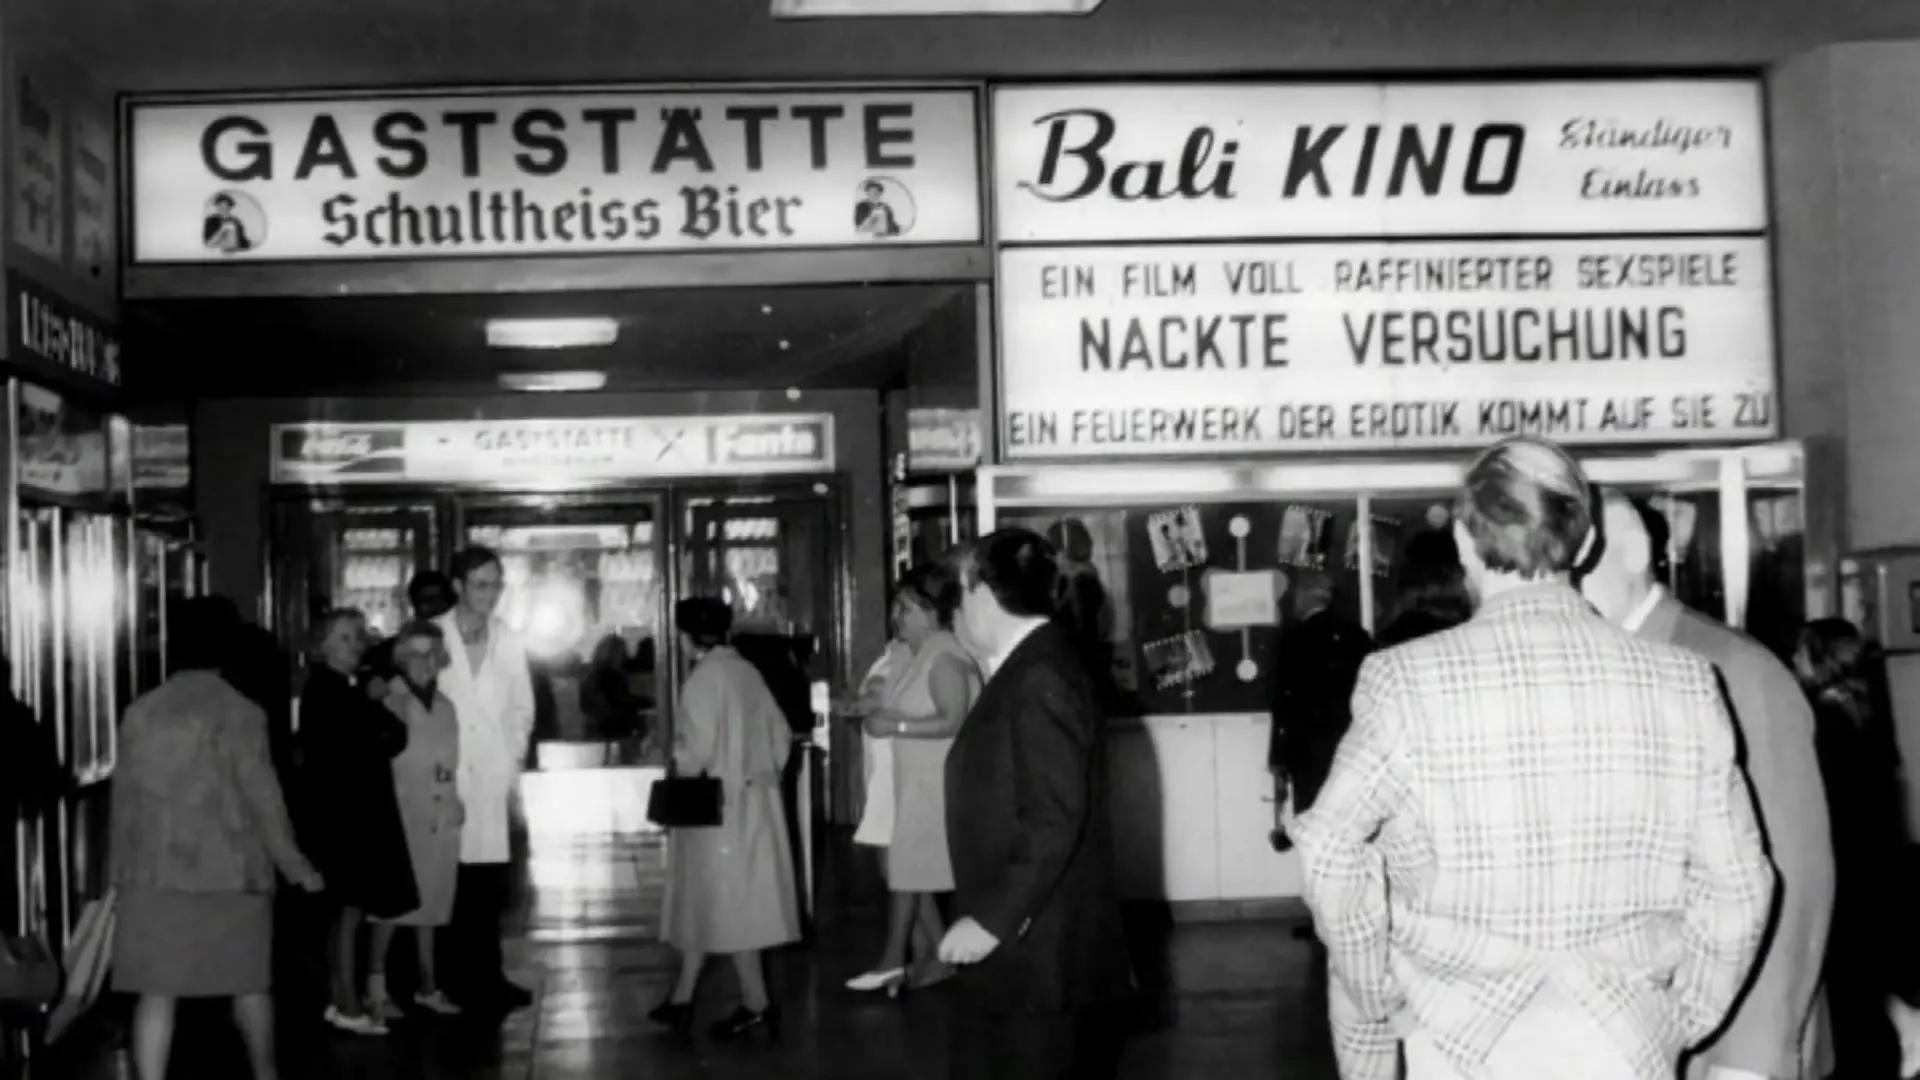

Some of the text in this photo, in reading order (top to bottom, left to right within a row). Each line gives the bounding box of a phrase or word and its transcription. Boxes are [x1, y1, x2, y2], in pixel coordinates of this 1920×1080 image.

[201, 102, 916, 180] GASTSTÄTTE
[1016, 107, 1527, 203] Bali KINO
[321, 184, 804, 247] Schultheiss Bier
[1041, 252, 1737, 299] EIN FILM VOLL RAFFINIERTER SEXSPIELE
[1079, 305, 1688, 373] NACKTE VERSUCHUNG
[1008, 412, 1058, 445] EIN
[1071, 407, 1261, 444] FEUERWERK
[1278, 404, 1335, 440] DER
[1350, 401, 1459, 437] EROTIK
[1479, 400, 1588, 435] KOMMT
[1599, 396, 1655, 429] AUF
[1671, 394, 1716, 428] SIE
[1734, 392, 1770, 428] ZU
